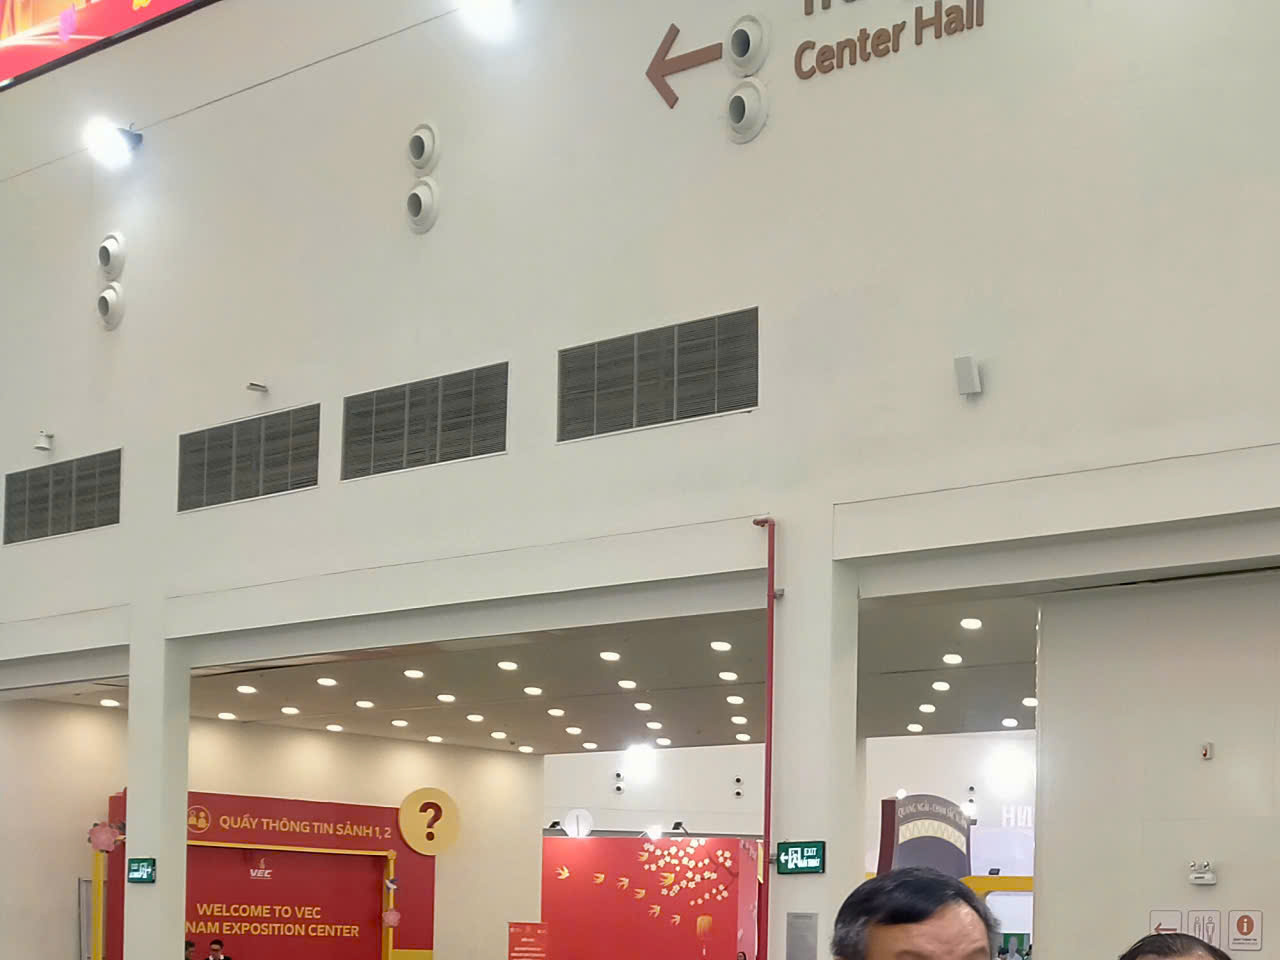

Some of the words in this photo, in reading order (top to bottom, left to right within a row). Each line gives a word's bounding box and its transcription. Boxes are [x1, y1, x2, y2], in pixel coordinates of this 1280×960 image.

[793, 20, 907, 80] Center
[914, 0, 985, 46] Hall
[261, 816, 310, 834] THÔNG
[312, 822, 334, 835] TIN
[336, 821, 373, 838] SẢNH
[384, 827, 392, 839] 2
[803, 847, 818, 856] EXIT
[250, 868, 272, 878] VEC
[196, 903, 271, 918] WELCOME
[273, 905, 292, 918] TO
[294, 906, 321, 919] VEC
[222, 922, 305, 936] EXPOSITION
[307, 924, 360, 937] CENTER
